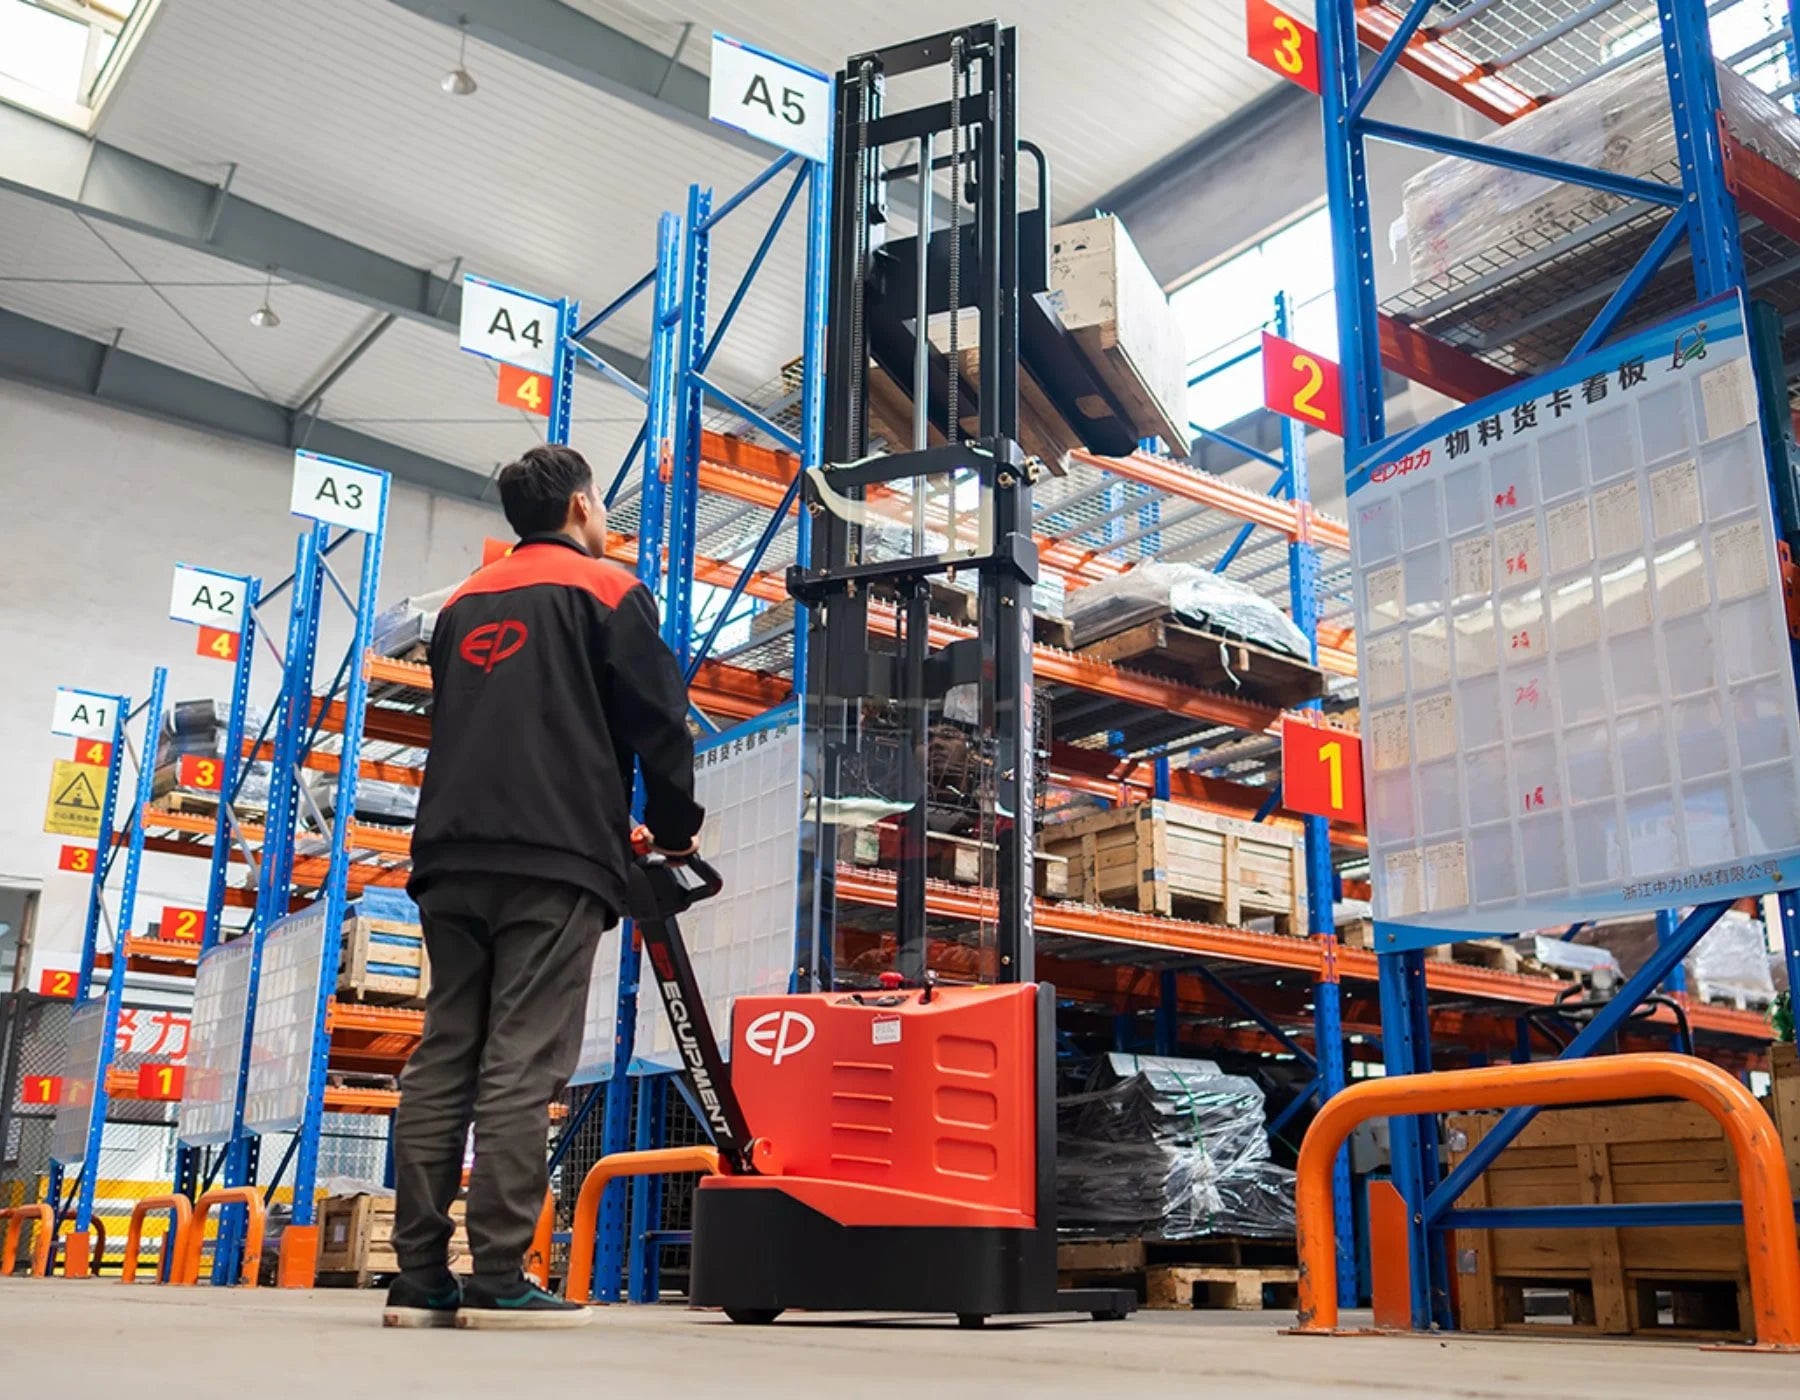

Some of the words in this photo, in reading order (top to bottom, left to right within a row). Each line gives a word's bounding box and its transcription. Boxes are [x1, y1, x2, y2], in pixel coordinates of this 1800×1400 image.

[1273, 16, 1303, 74] 3
[741, 73, 806, 126] A5
[487, 307, 544, 350] A4
[516, 375, 543, 409] 4
[1291, 354, 1327, 421] 2
[1444, 355, 1648, 460] 物料货卡看板
[314, 476, 364, 511] A3
[191, 584, 236, 616] A2
[211, 633, 232, 657] 4
[460, 620, 529, 674] EP
[70, 703, 106, 728] A1
[86, 743, 106, 763] 4
[195, 760, 216, 787] 3
[1318, 741, 1344, 810] 1
[70, 848, 90, 871] 3
[1622, 858, 1778, 901] 浙江中力机械有限公司
[175, 910, 198, 939] 2
[52, 972, 72, 995] 2
[745, 1010, 816, 1065] EP
[662, 980, 733, 1139] EQUIPMENT
[38, 1078, 53, 1102] 1
[157, 1066, 174, 1096] 1
